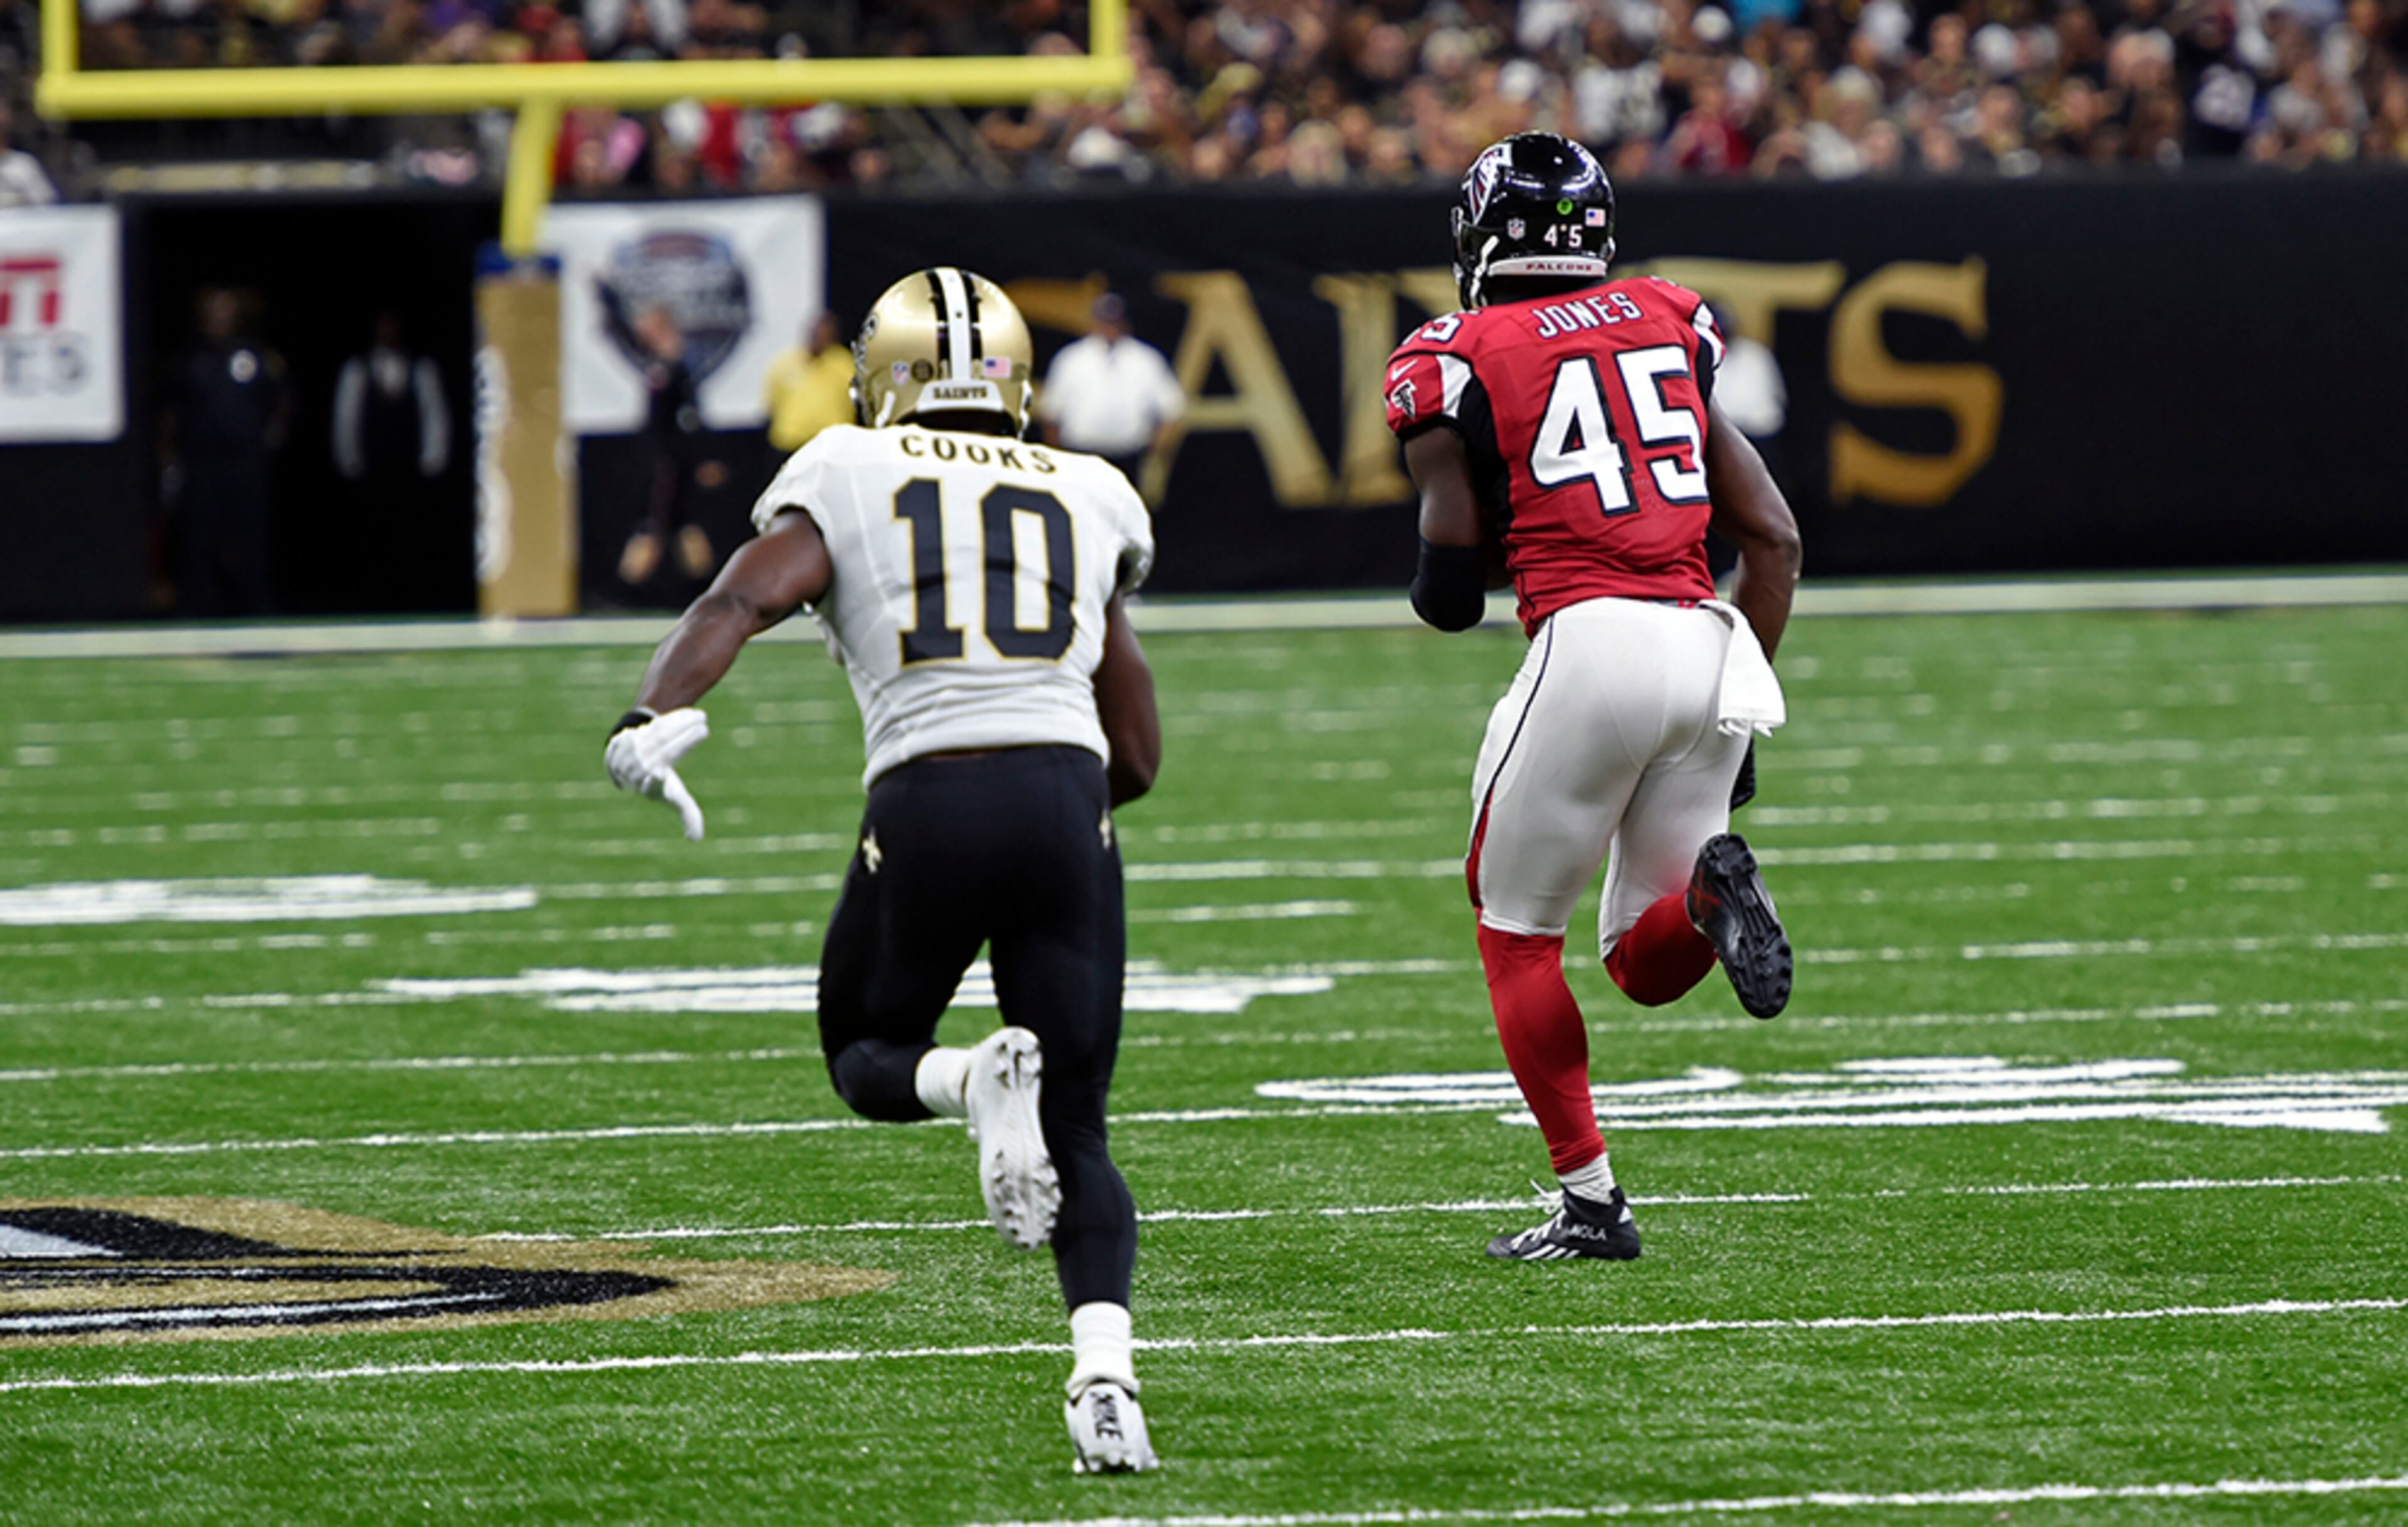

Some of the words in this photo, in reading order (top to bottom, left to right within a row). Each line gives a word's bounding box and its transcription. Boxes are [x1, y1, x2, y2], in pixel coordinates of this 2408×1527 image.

[1543, 223, 1583, 248] 45
[1525, 262, 1593, 272] FALCONS
[1531, 292, 1643, 339] JONES
[932, 386, 988, 399] SAINTS
[1529, 343, 1709, 518] 45
[899, 435, 1058, 475] COOKS
[890, 477, 1079, 669] 10
